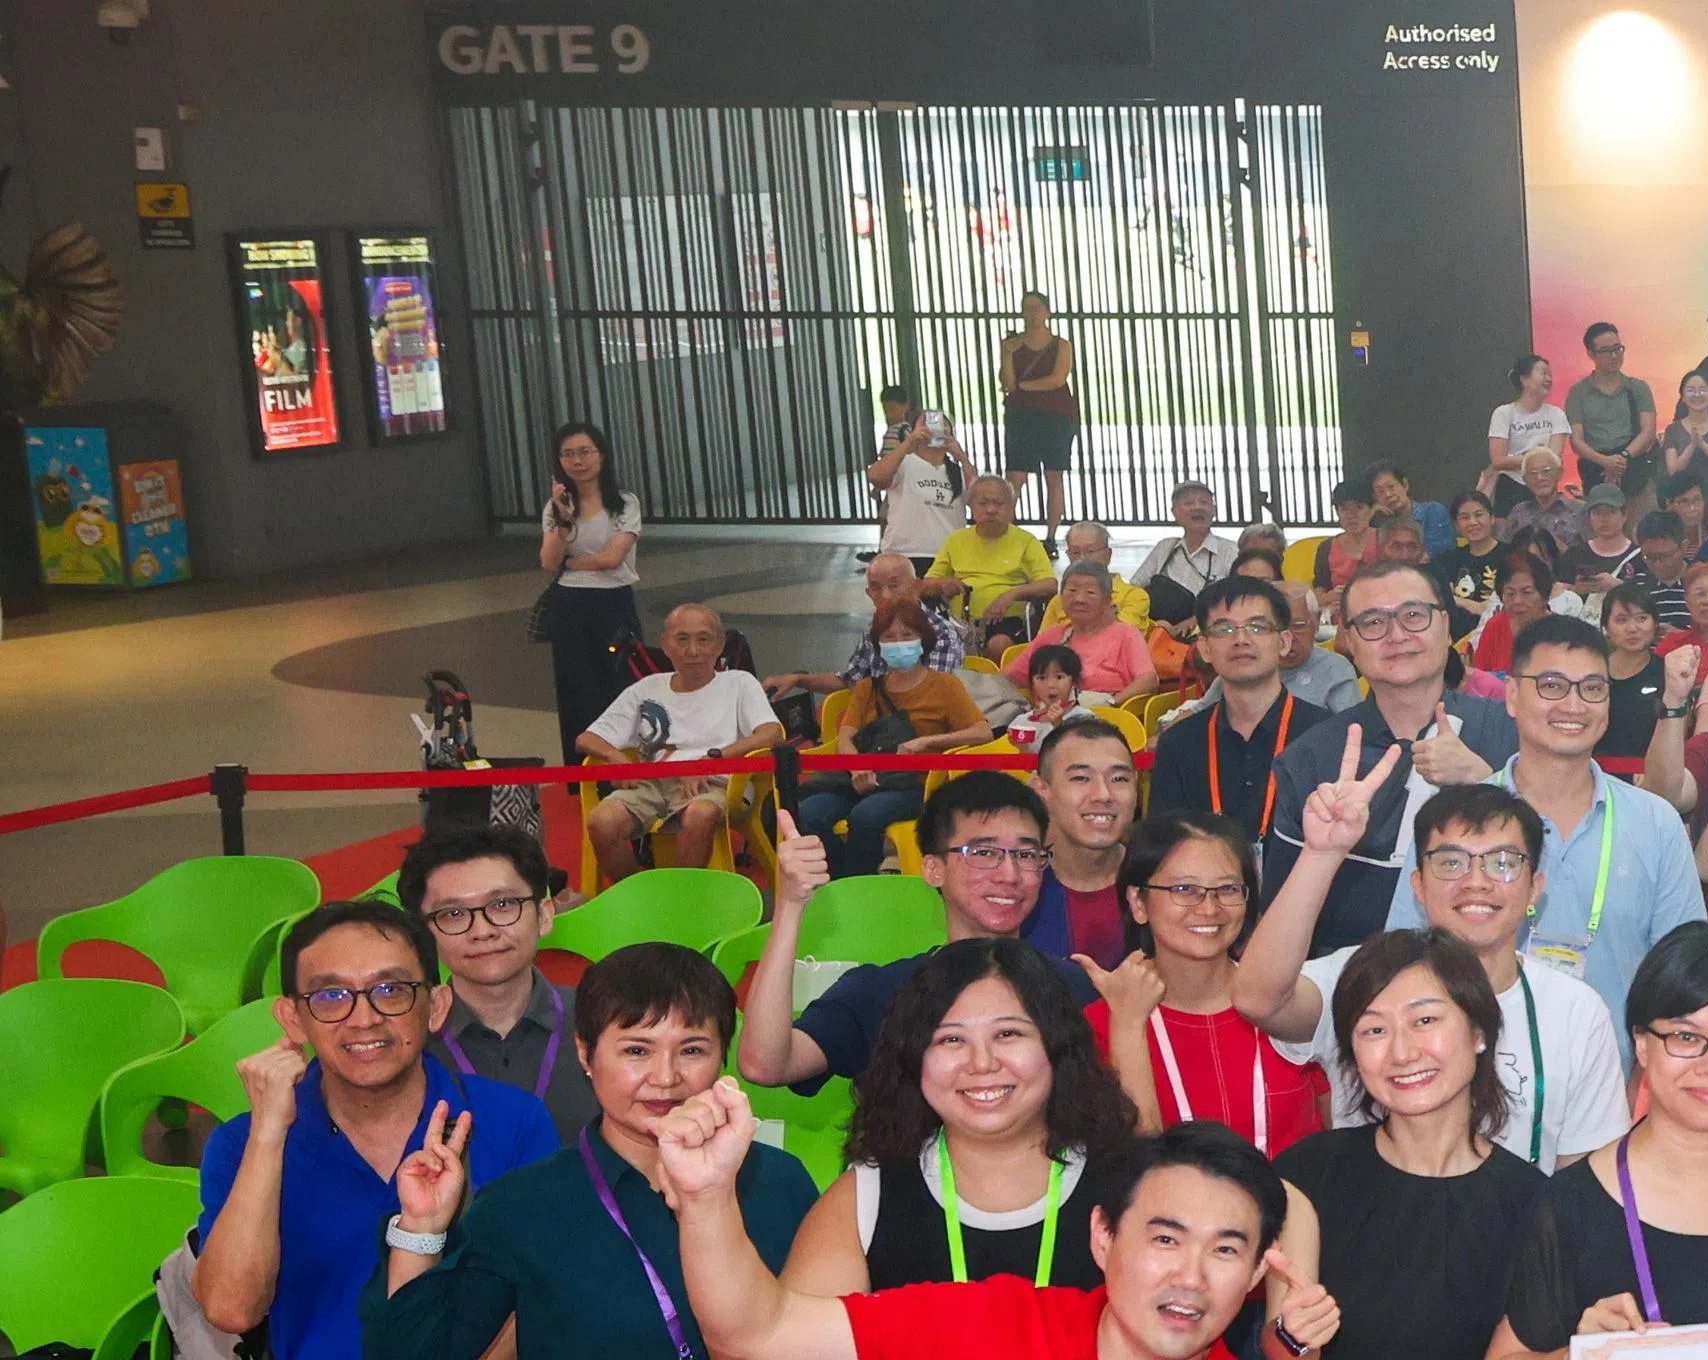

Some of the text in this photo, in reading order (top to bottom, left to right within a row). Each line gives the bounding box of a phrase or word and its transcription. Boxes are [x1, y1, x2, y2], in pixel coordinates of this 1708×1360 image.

[1385, 23, 1496, 43] Authorised
[438, 24, 650, 75] GATE 9
[1383, 50, 1500, 72] Access only
[263, 388, 313, 412] FILM
